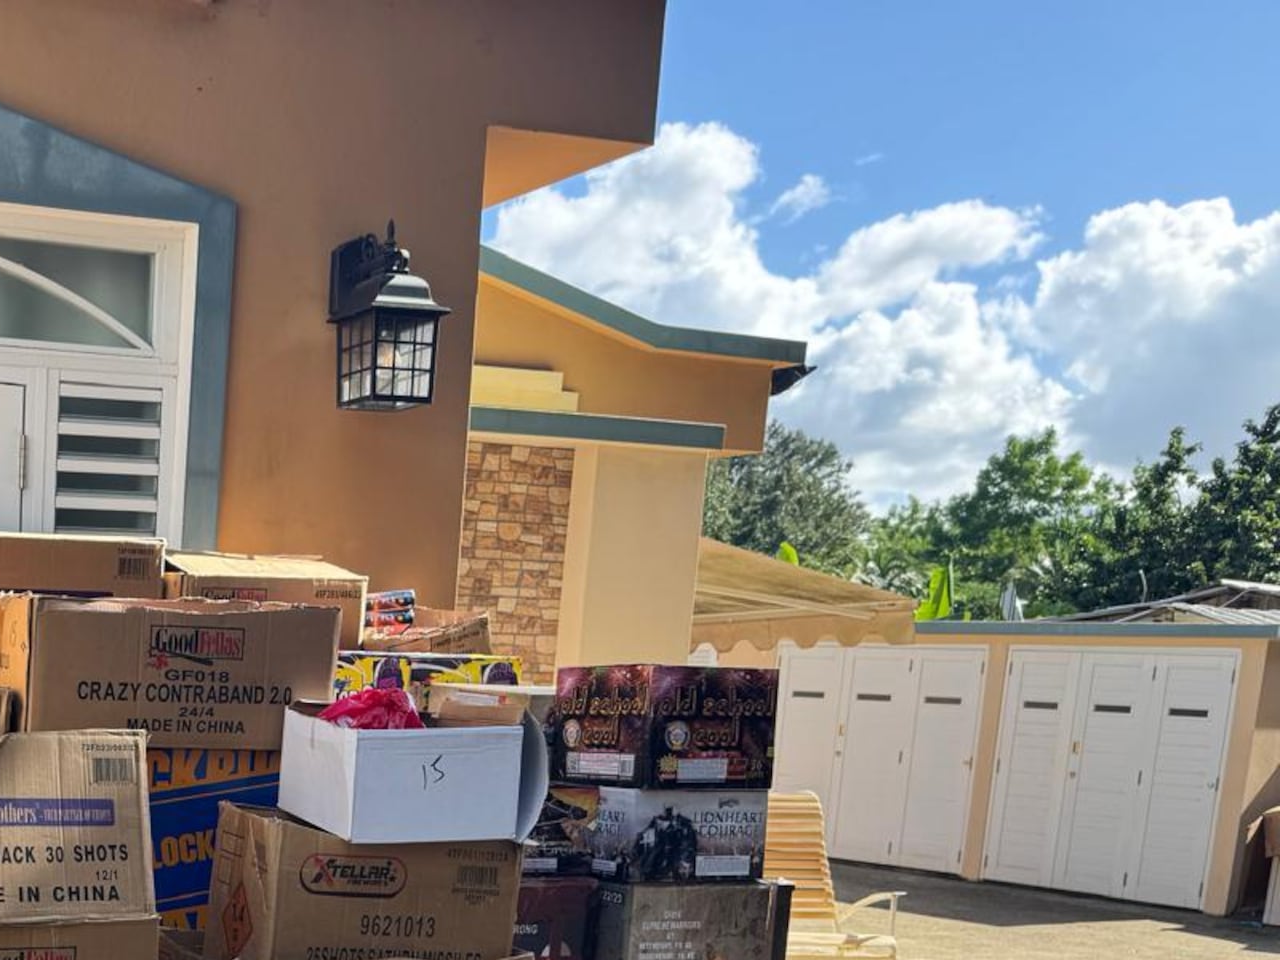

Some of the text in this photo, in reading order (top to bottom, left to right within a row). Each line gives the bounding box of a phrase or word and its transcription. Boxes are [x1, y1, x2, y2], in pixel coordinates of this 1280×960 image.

[165, 670, 230, 682] GF018
[78, 681, 292, 706] CRAZY CONTRABAND 2.0
[179, 708, 214, 718] 24/4
[127, 719, 245, 735] MADE IN CHINA
[694, 811, 763, 823] LIONHEART
[46, 847, 64, 863] 30
[74, 844, 128, 862] SHOTS
[96, 870, 118, 881] 12/1
[19, 886, 40, 902] IN
[53, 886, 120, 902] CHINA
[360, 914, 437, 938] 9621013
